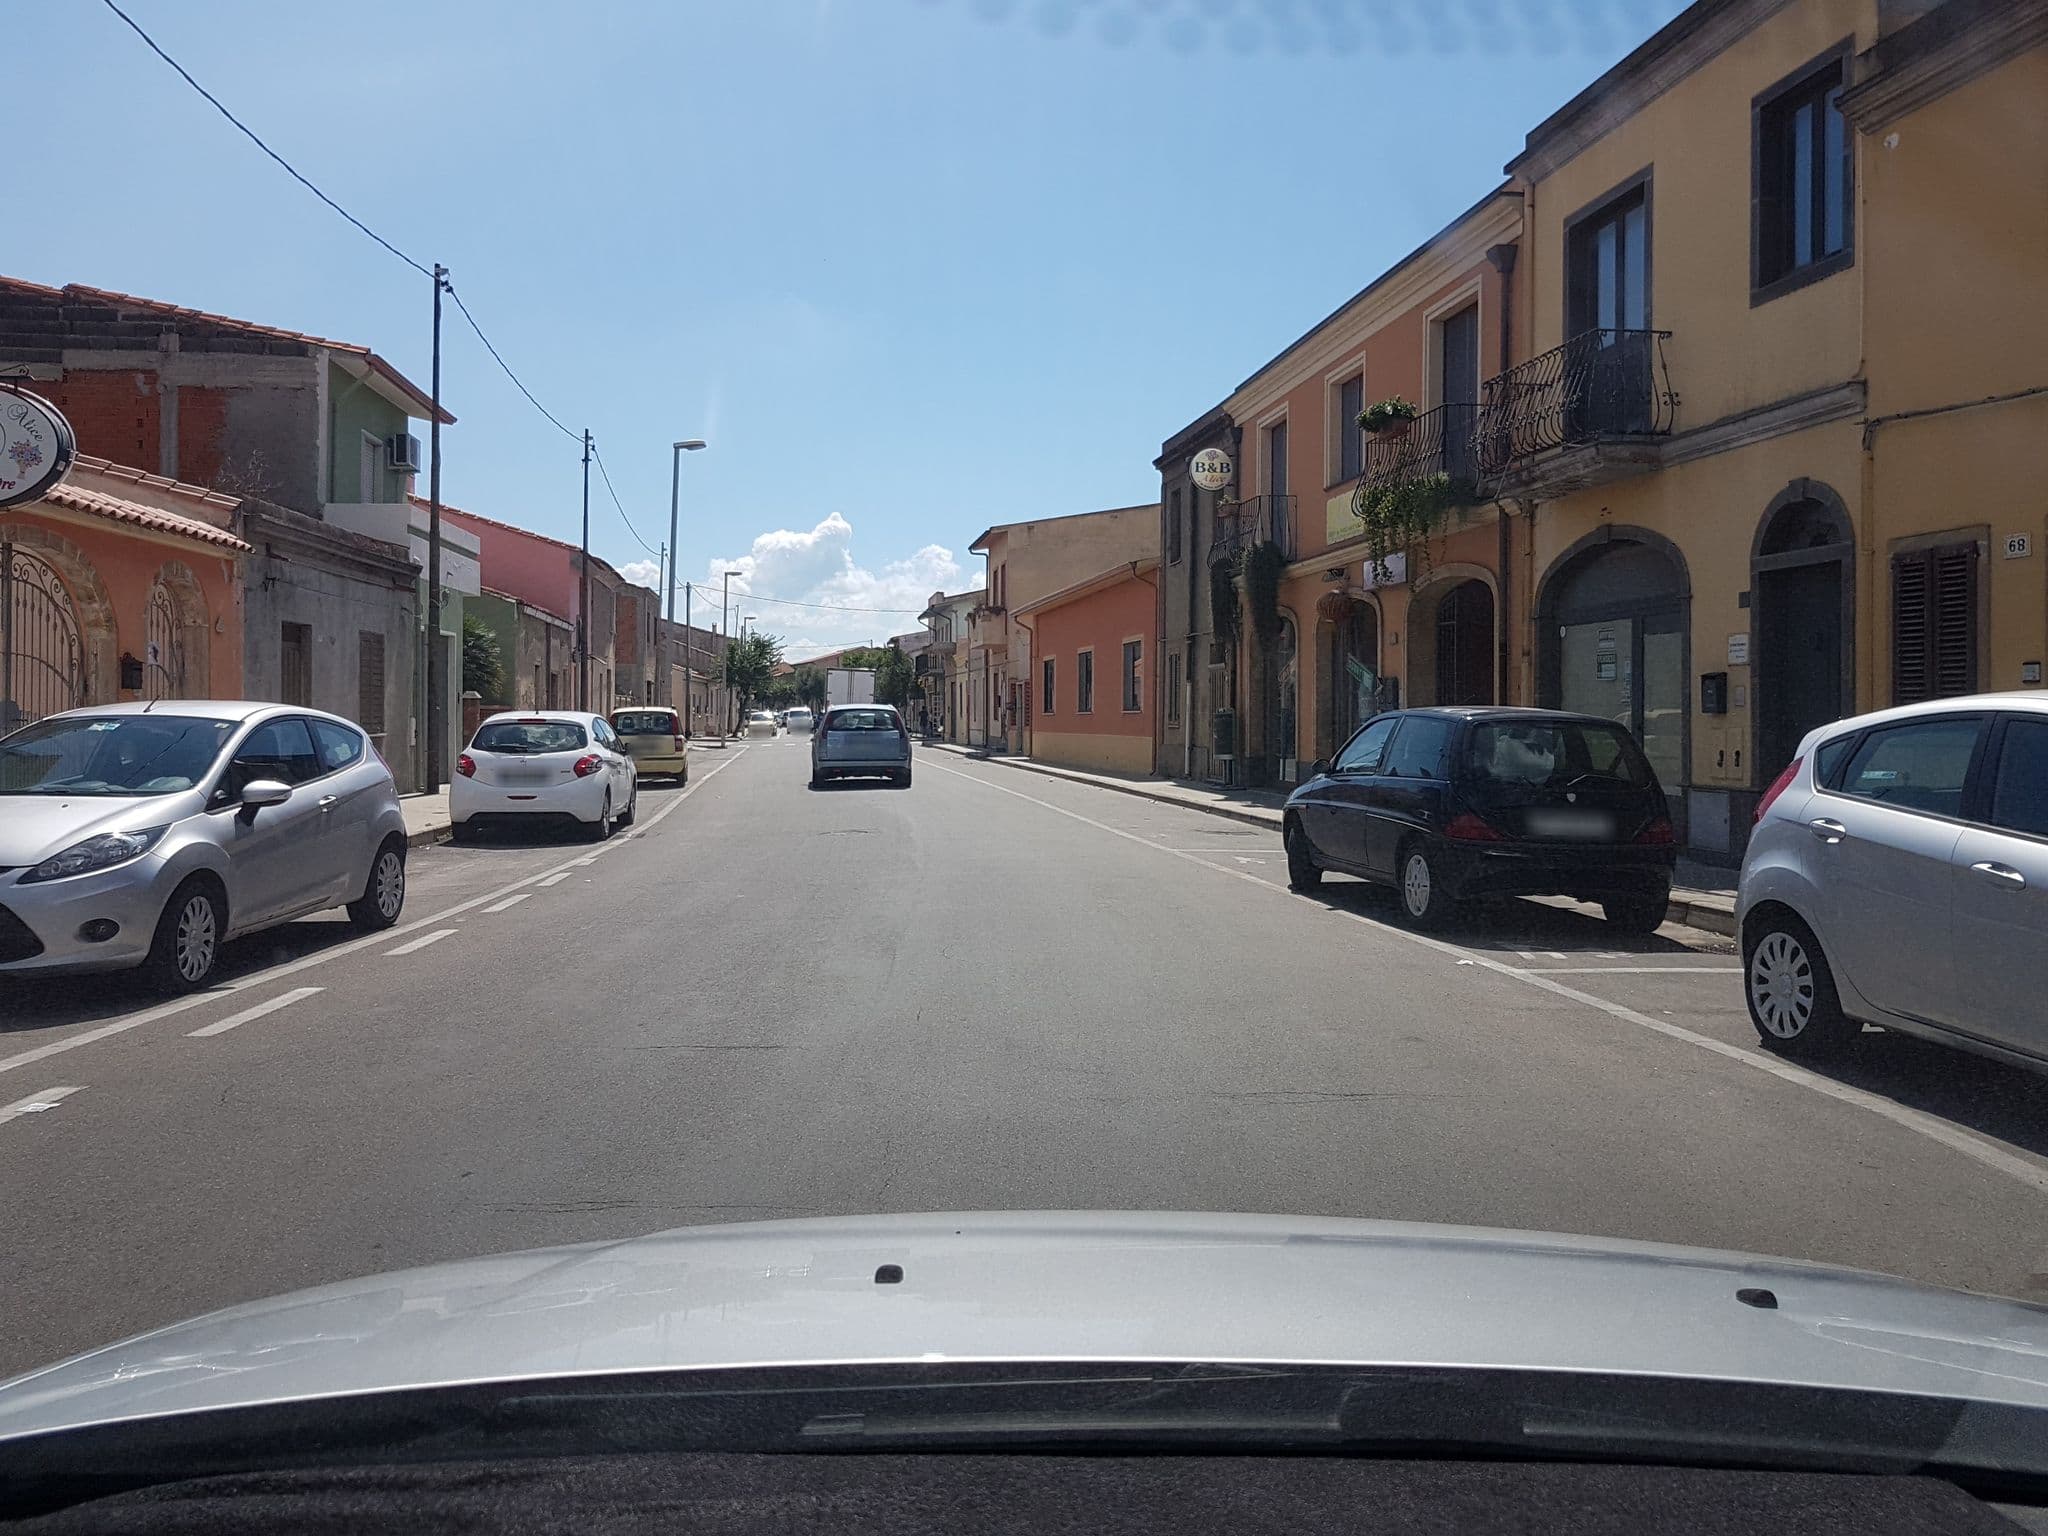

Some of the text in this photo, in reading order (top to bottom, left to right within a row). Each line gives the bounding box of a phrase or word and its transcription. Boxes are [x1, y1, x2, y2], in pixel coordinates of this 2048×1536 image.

[7, 403, 44, 442] Alice
[1195, 462, 1231, 473] B&B
[2009, 538, 2025, 552] 68
